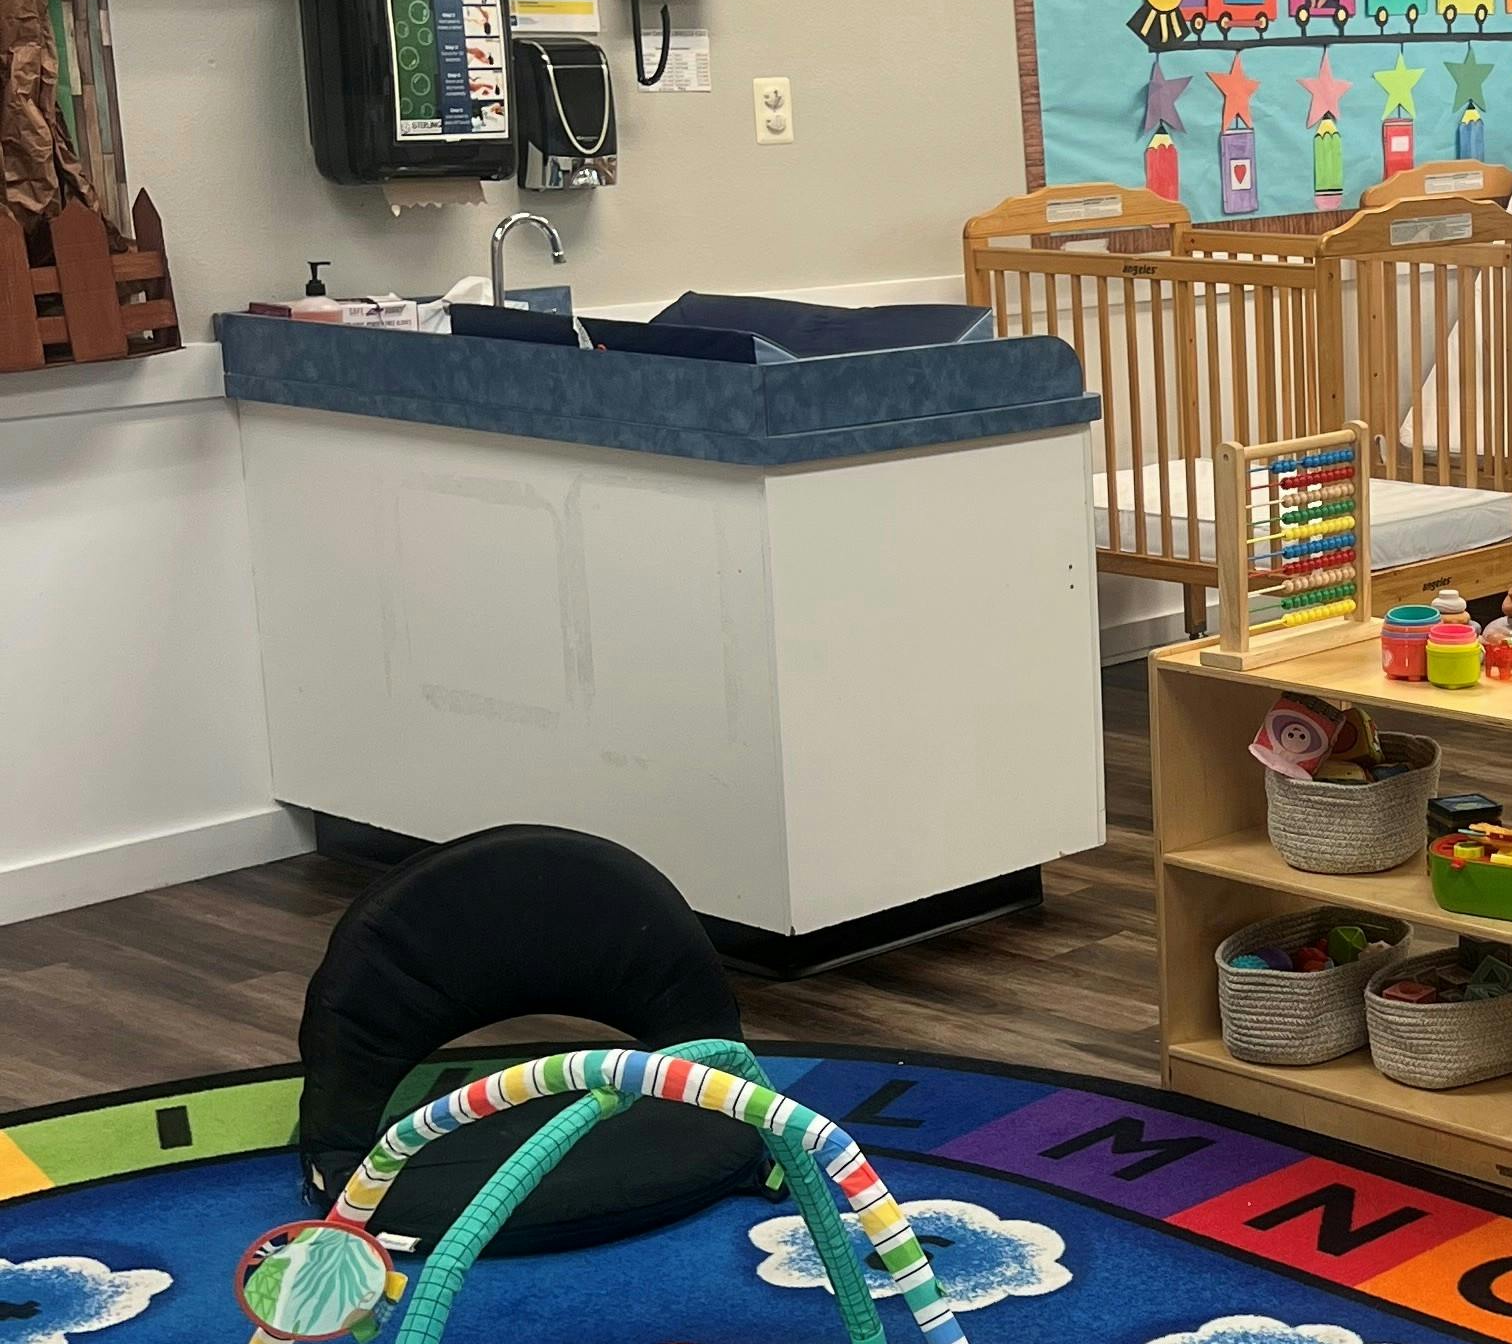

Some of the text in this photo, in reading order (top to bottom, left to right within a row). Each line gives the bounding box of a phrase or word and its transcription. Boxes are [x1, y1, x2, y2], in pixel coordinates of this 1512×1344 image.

[840, 1079, 926, 1128] L
[1037, 1116, 1216, 1181] M
[1244, 1185, 1431, 1256] N
